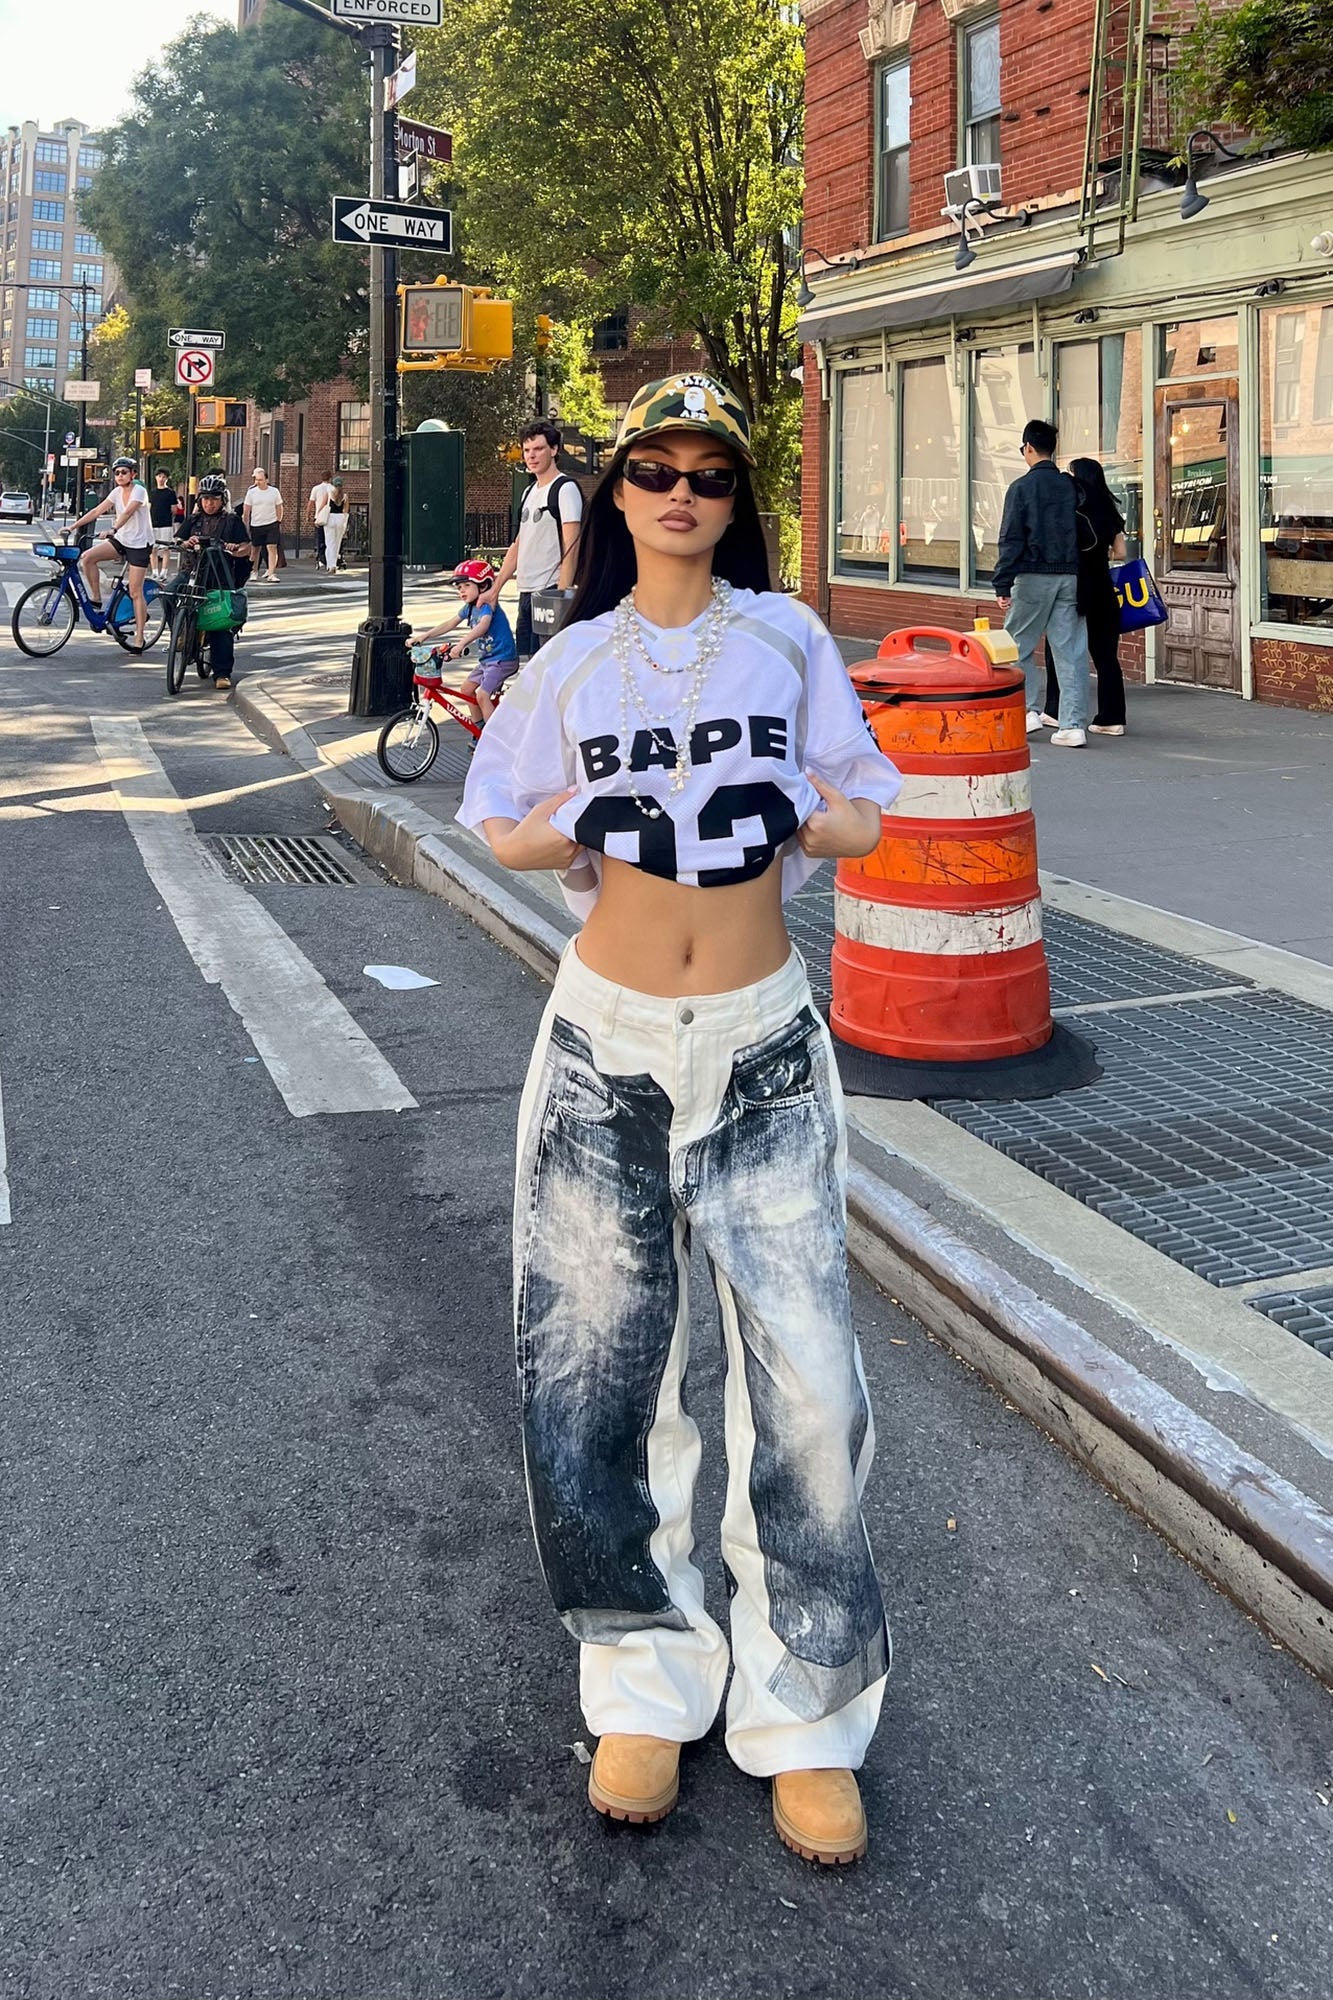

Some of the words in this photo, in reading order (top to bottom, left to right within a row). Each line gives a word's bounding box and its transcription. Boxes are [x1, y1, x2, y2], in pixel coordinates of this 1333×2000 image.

[344, 0, 430, 16] ENFORCED
[427, 136, 437, 157] St
[354, 213, 389, 232] ONE
[404, 218, 437, 238] WAY
[174, 334, 193, 343] ONE
[202, 336, 220, 344] WAY
[579, 715, 788, 784] BAPE
